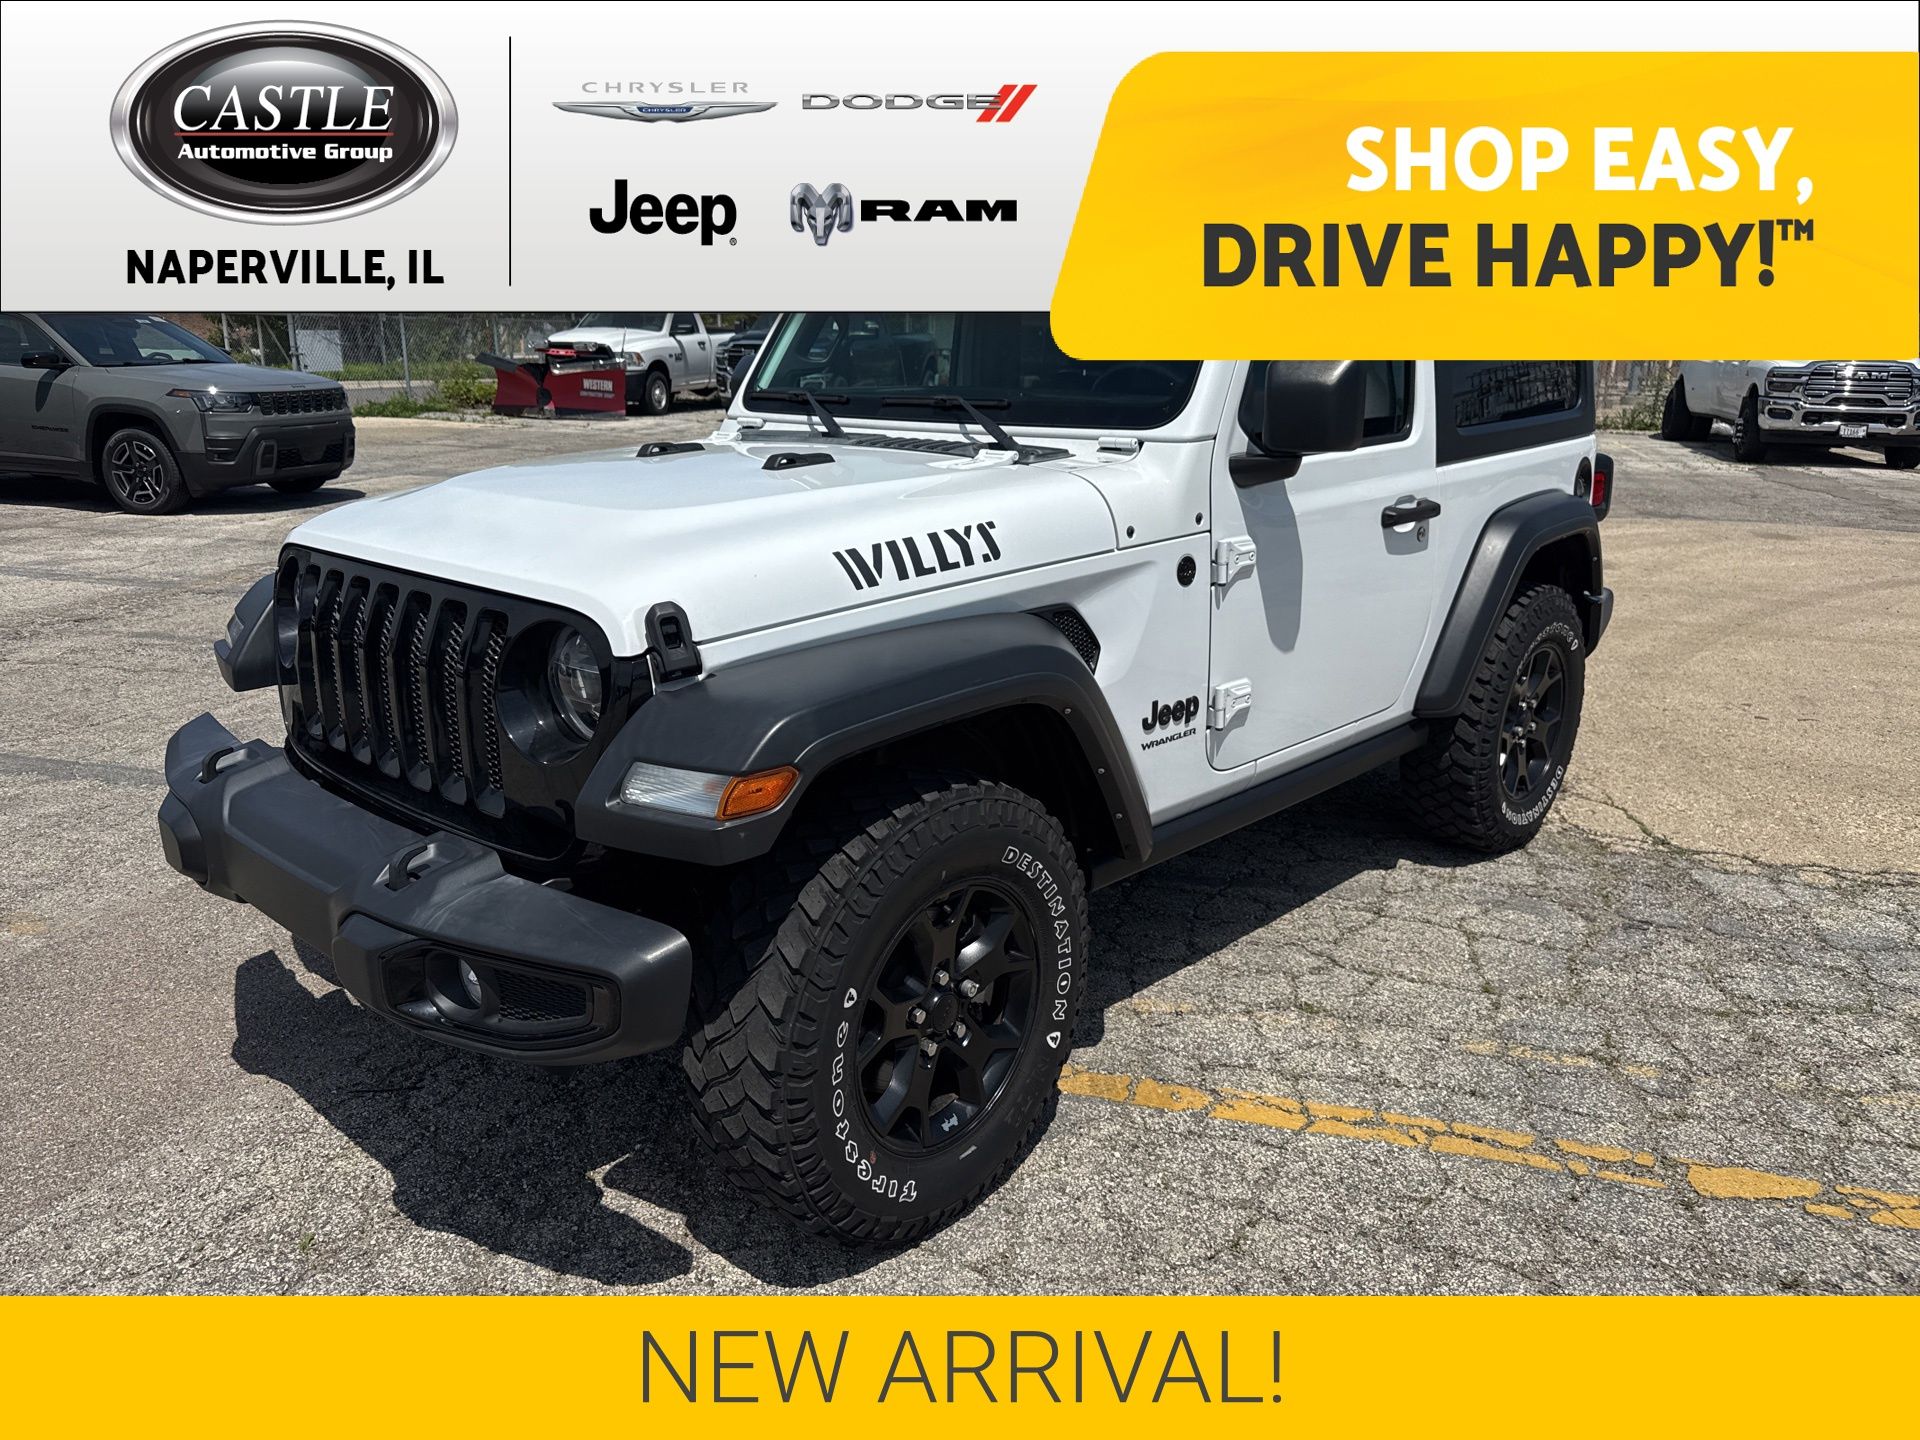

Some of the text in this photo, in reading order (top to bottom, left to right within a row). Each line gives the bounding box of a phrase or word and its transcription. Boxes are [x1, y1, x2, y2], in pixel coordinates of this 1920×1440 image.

[582, 378, 613, 391] WESTERN
[832, 520, 1002, 591] WILLYS
[1140, 727, 1197, 751] WRANGLER
[1141, 695, 1200, 732] Jeep
[1505, 766, 1564, 826] DESTINATION
[1002, 845, 1072, 1021] DESTINATION
[831, 1020, 918, 1203] Firestone
